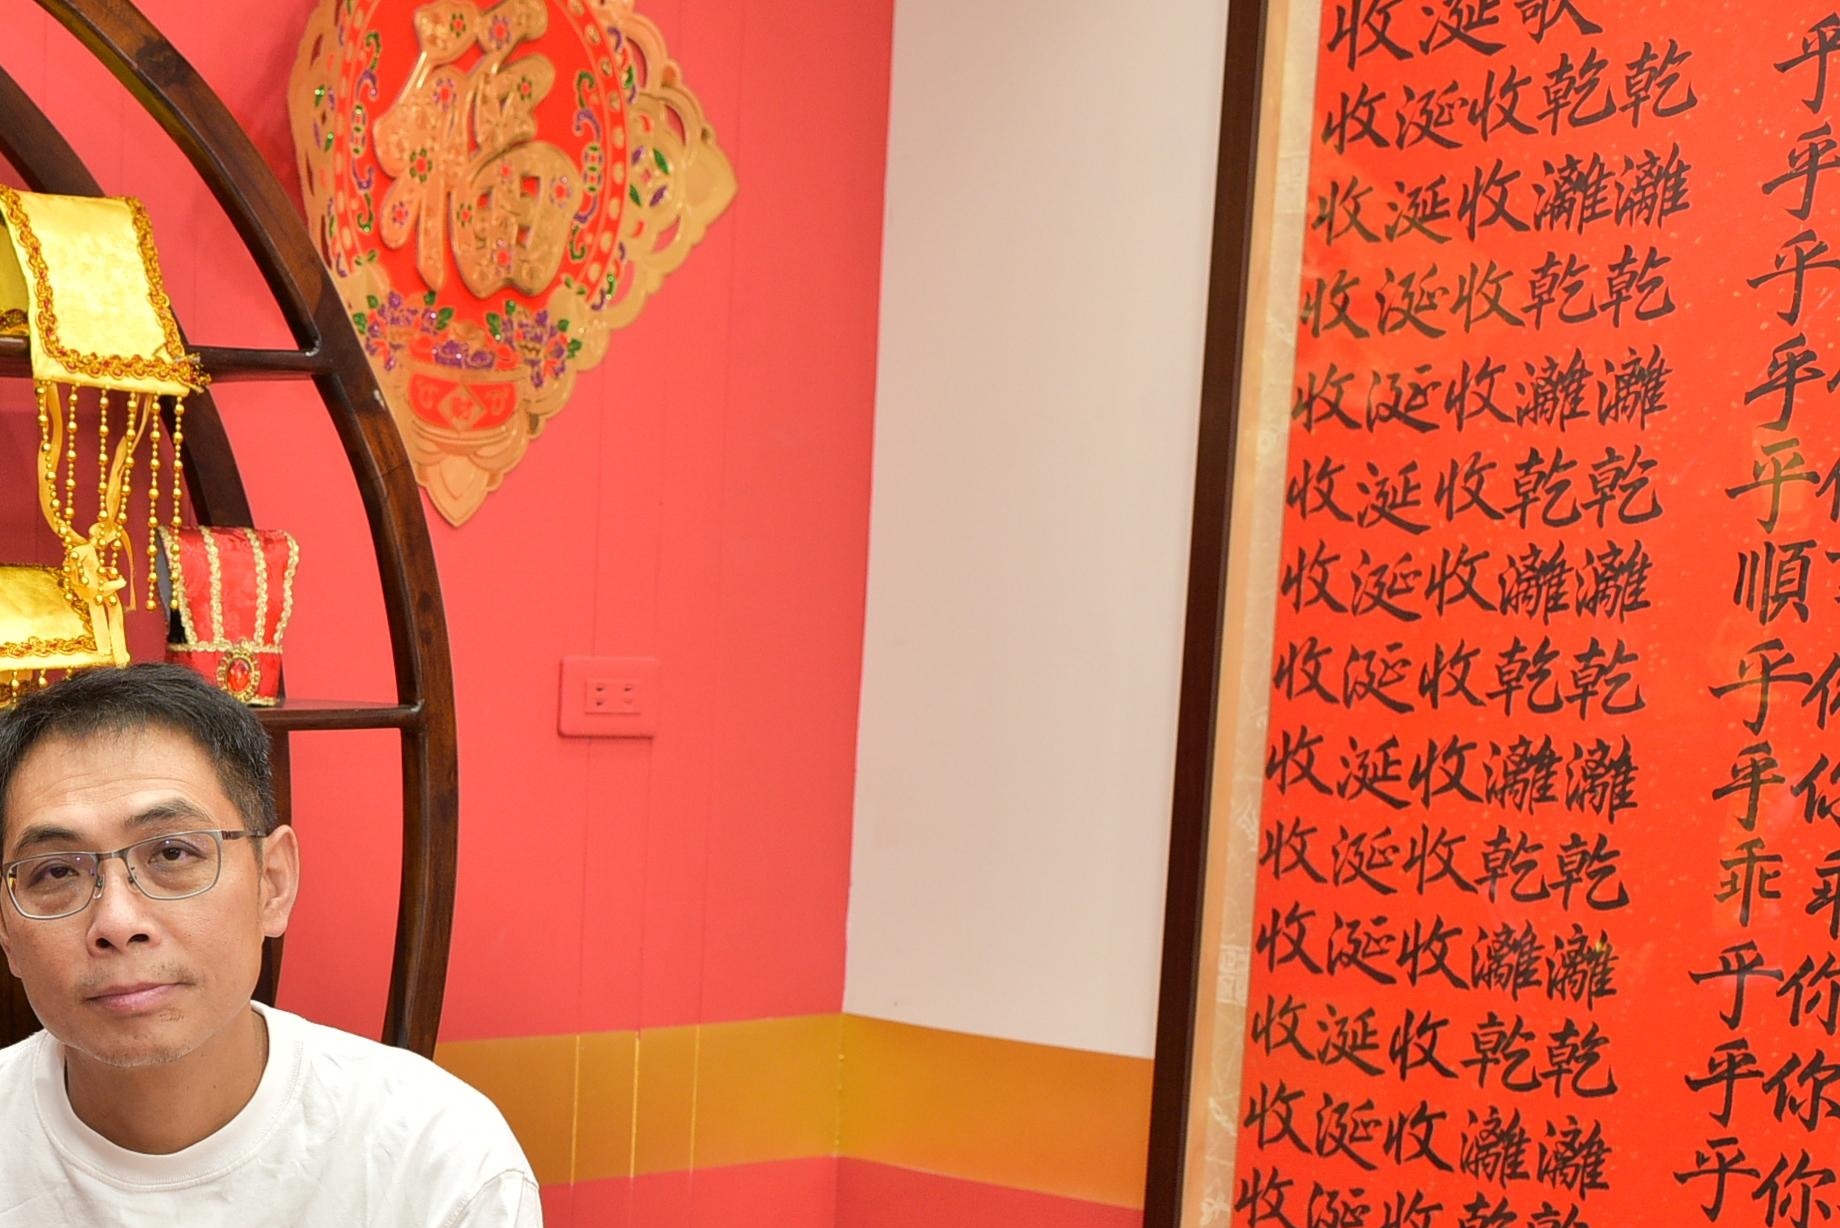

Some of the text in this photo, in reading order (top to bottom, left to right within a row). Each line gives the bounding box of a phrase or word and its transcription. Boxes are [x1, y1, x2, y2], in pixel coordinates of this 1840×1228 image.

[1328, 0, 1602, 70] 收涎歌
[1322, 40, 1697, 153] 收涎收乾乾
[1301, 246, 1675, 337] 收涎收乾乾
[1286, 446, 1662, 535] 收涎收乾乾
[1733, 539, 1840, 626] 順
[1273, 637, 1645, 720] 收涎收乾乾
[1259, 818, 1629, 910] 收涎收乾乾
[1252, 995, 1618, 1097] 收涎收乾乾
